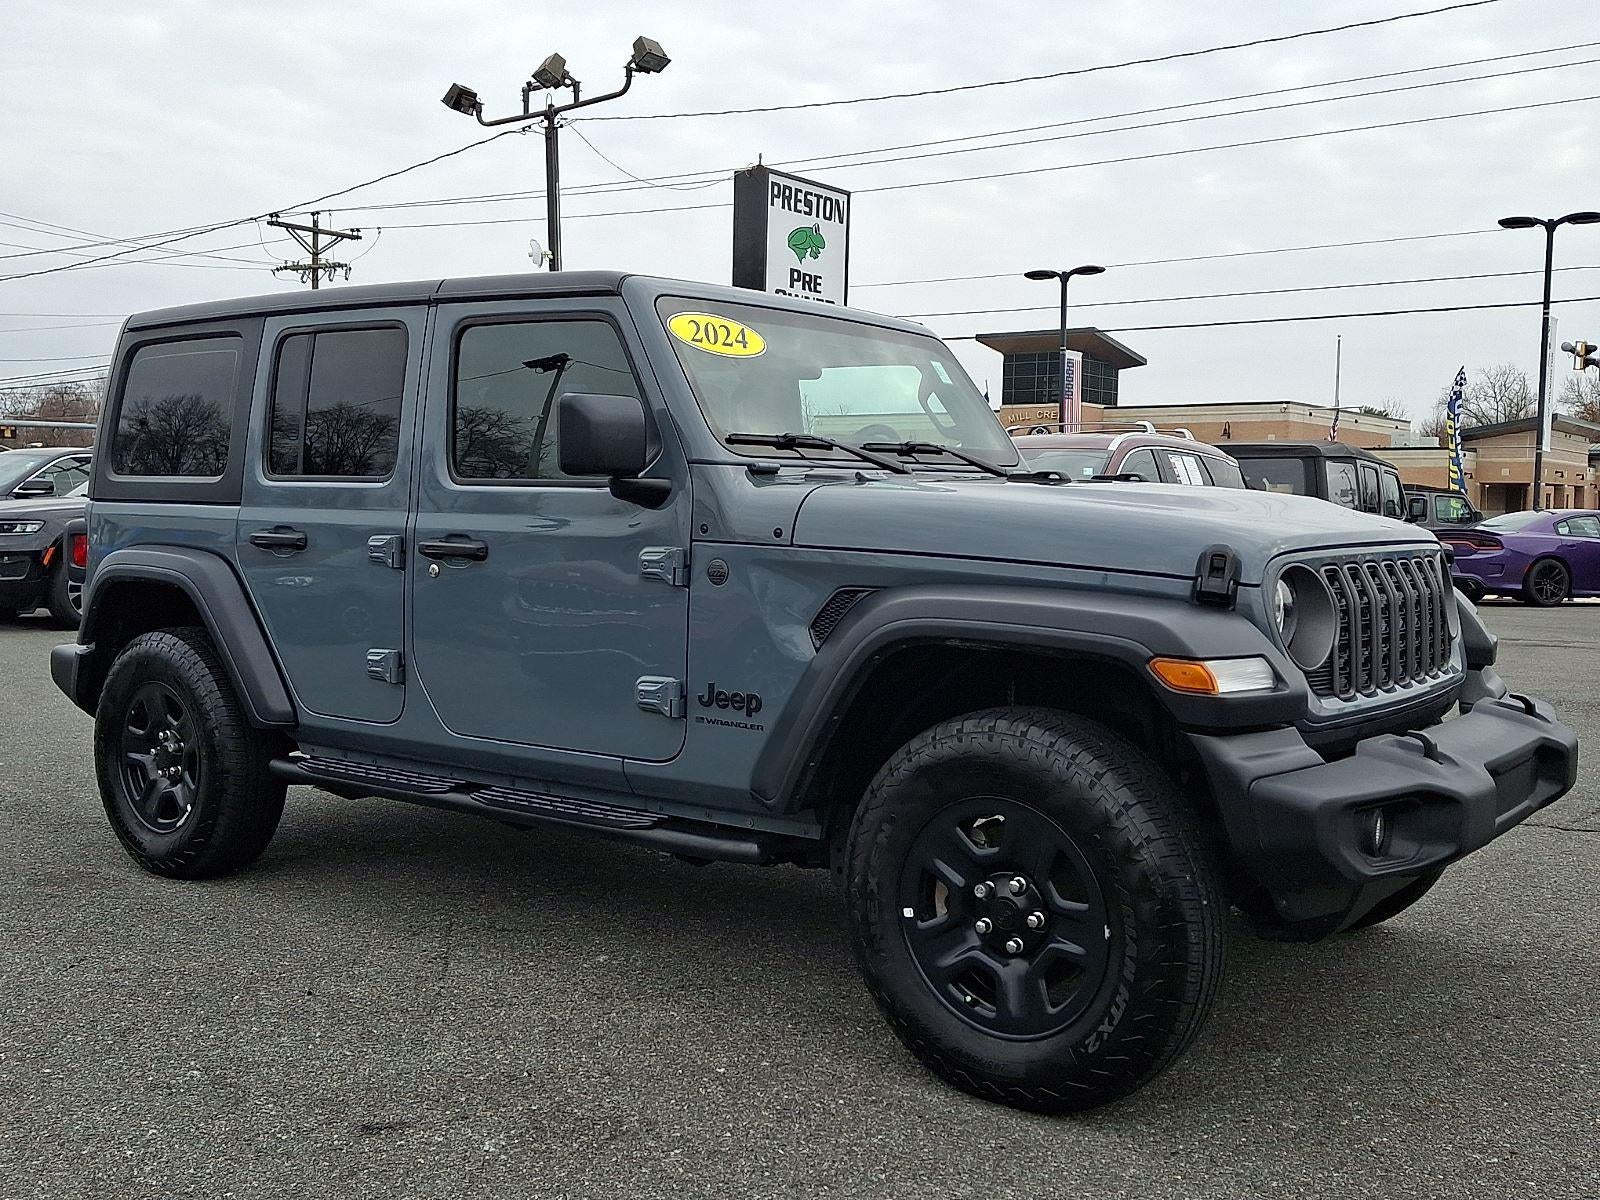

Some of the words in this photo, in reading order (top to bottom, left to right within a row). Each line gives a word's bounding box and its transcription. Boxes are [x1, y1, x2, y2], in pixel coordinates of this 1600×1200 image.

[770, 180, 845, 224] PRESTON
[789, 267, 823, 294] PRE
[687, 319, 749, 349] 2024
[1008, 411, 1031, 423] MILL
[1036, 410, 1059, 420] CRE
[697, 681, 763, 718] Jeep
[705, 717, 764, 732] WRANGLER
